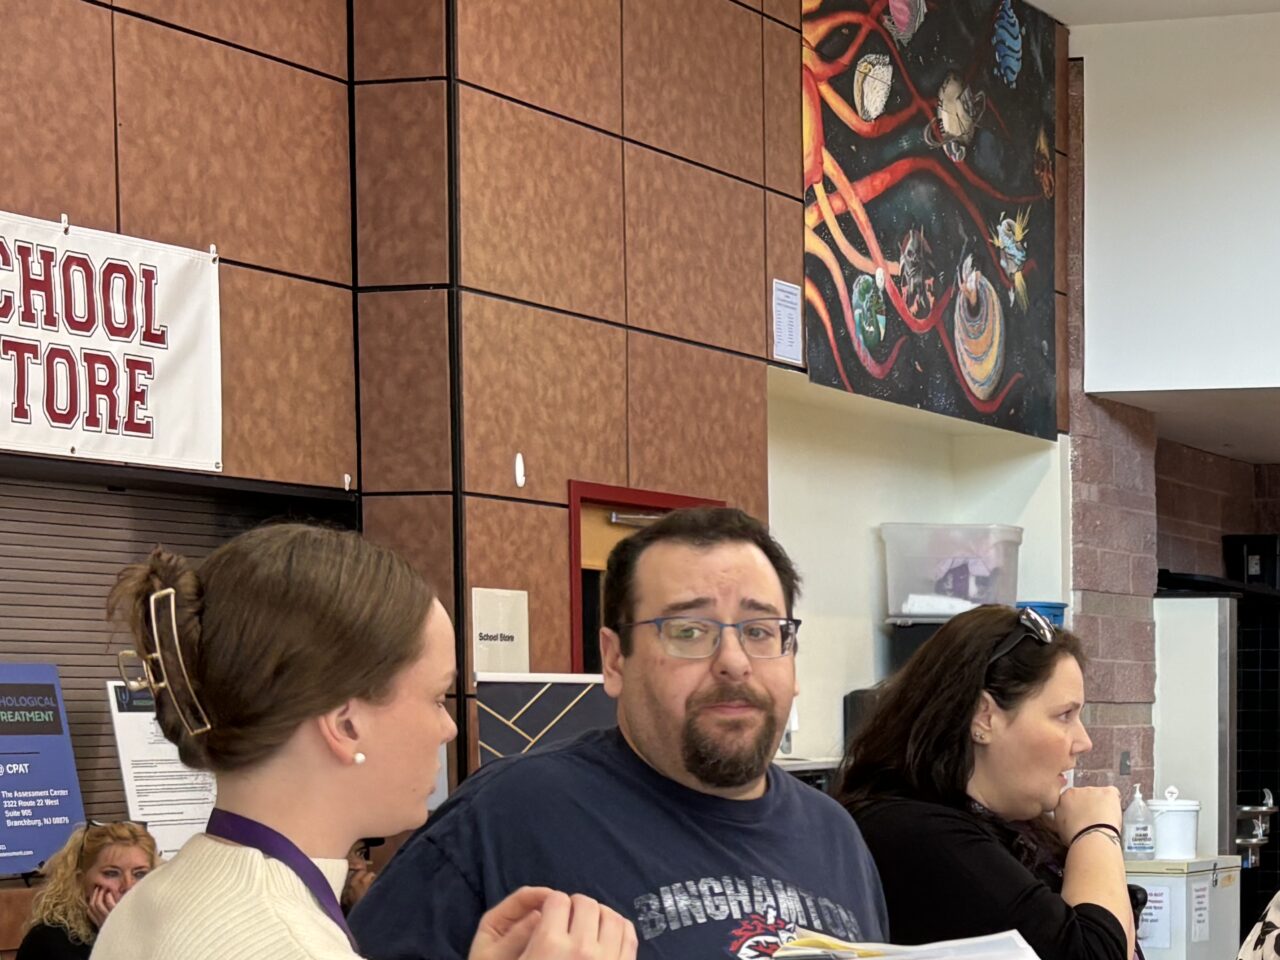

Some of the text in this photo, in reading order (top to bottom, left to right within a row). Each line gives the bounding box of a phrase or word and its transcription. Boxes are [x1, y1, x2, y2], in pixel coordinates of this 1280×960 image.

[478, 632, 498, 642] School
[6, 763, 30, 775] CPAT
[634, 875, 863, 941] BINGHAMTON
